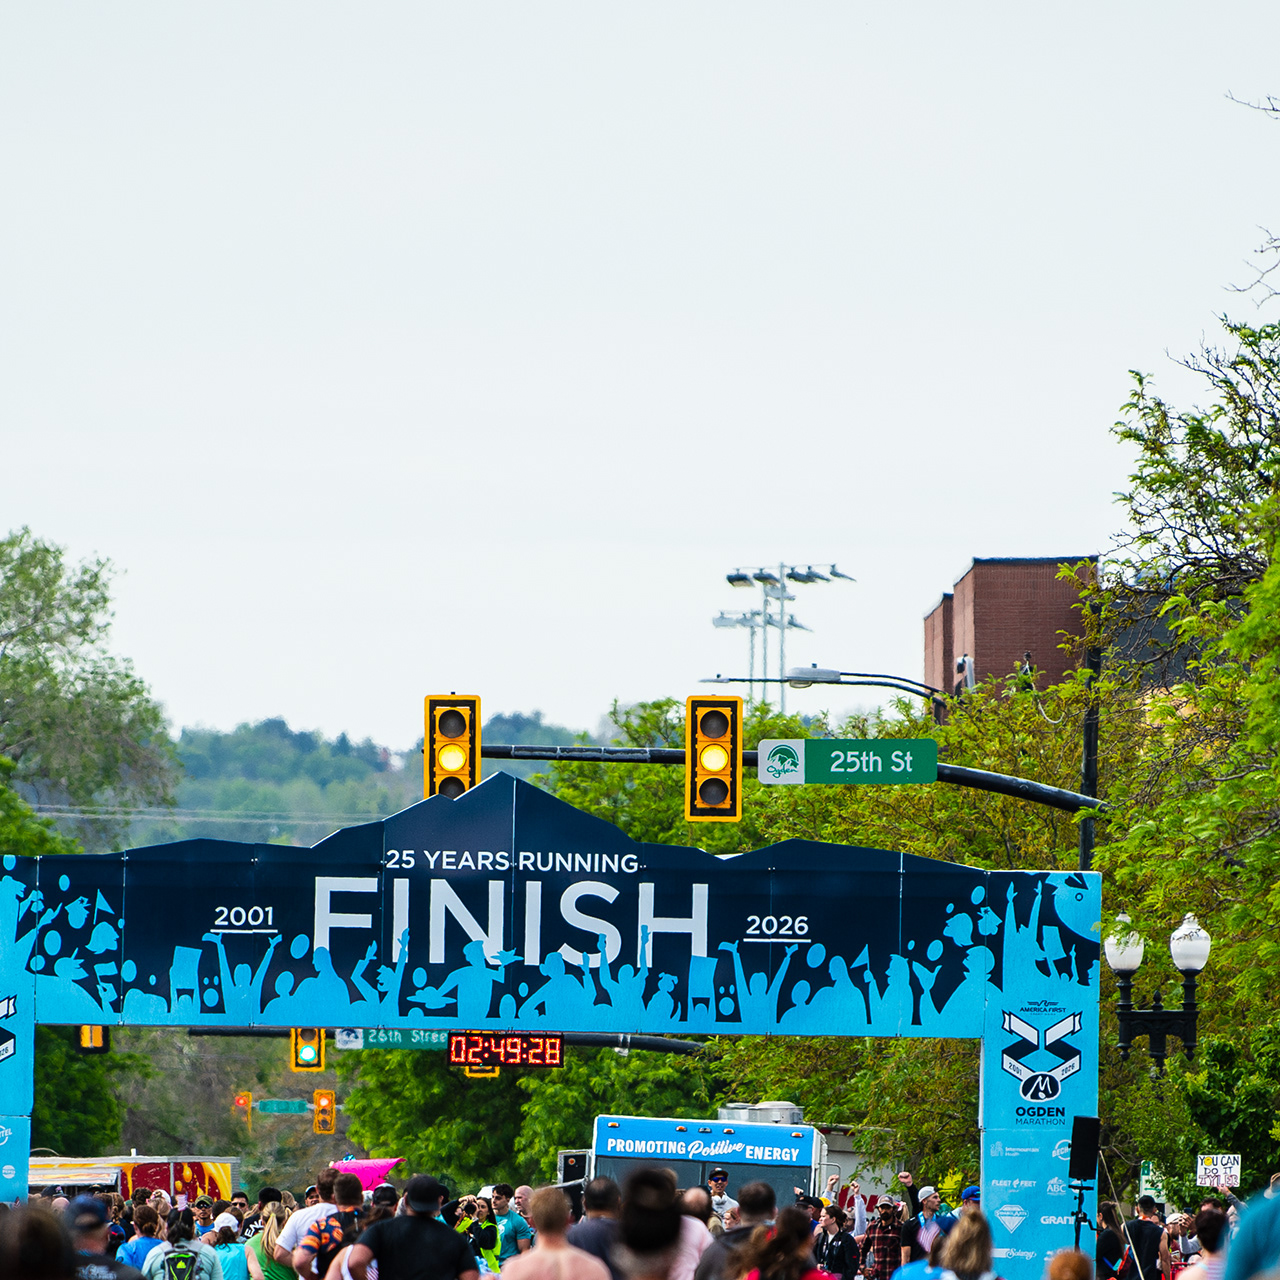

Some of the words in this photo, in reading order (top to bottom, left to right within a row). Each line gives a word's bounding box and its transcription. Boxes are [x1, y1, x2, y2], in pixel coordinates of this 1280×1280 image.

[830, 750, 882, 772] 25th
[890, 750, 913, 772] St
[386, 849, 415, 868] 25
[423, 850, 510, 870] YEARS
[519, 852, 639, 873] RUNNING
[214, 906, 274, 927] 2001
[314, 876, 708, 969] FINISH
[745, 915, 809, 936] 2026
[368, 1029, 402, 1043] 26th
[411, 1030, 448, 1043] Stree
[450, 1035, 561, 1065] 02:49:28
[1015, 1106, 1066, 1117] OGDEN
[607, 1138, 687, 1155] PROMOTING
[687, 1139, 745, 1159] Positive
[745, 1145, 800, 1162] ENERGY
[1051, 1147, 1070, 1158] BECH
[1220, 1156, 1240, 1167] CAN
[1204, 1167, 1219, 1175] DO
[1223, 1166, 1234, 1175] IT
[1046, 1184, 1067, 1193] ABC
